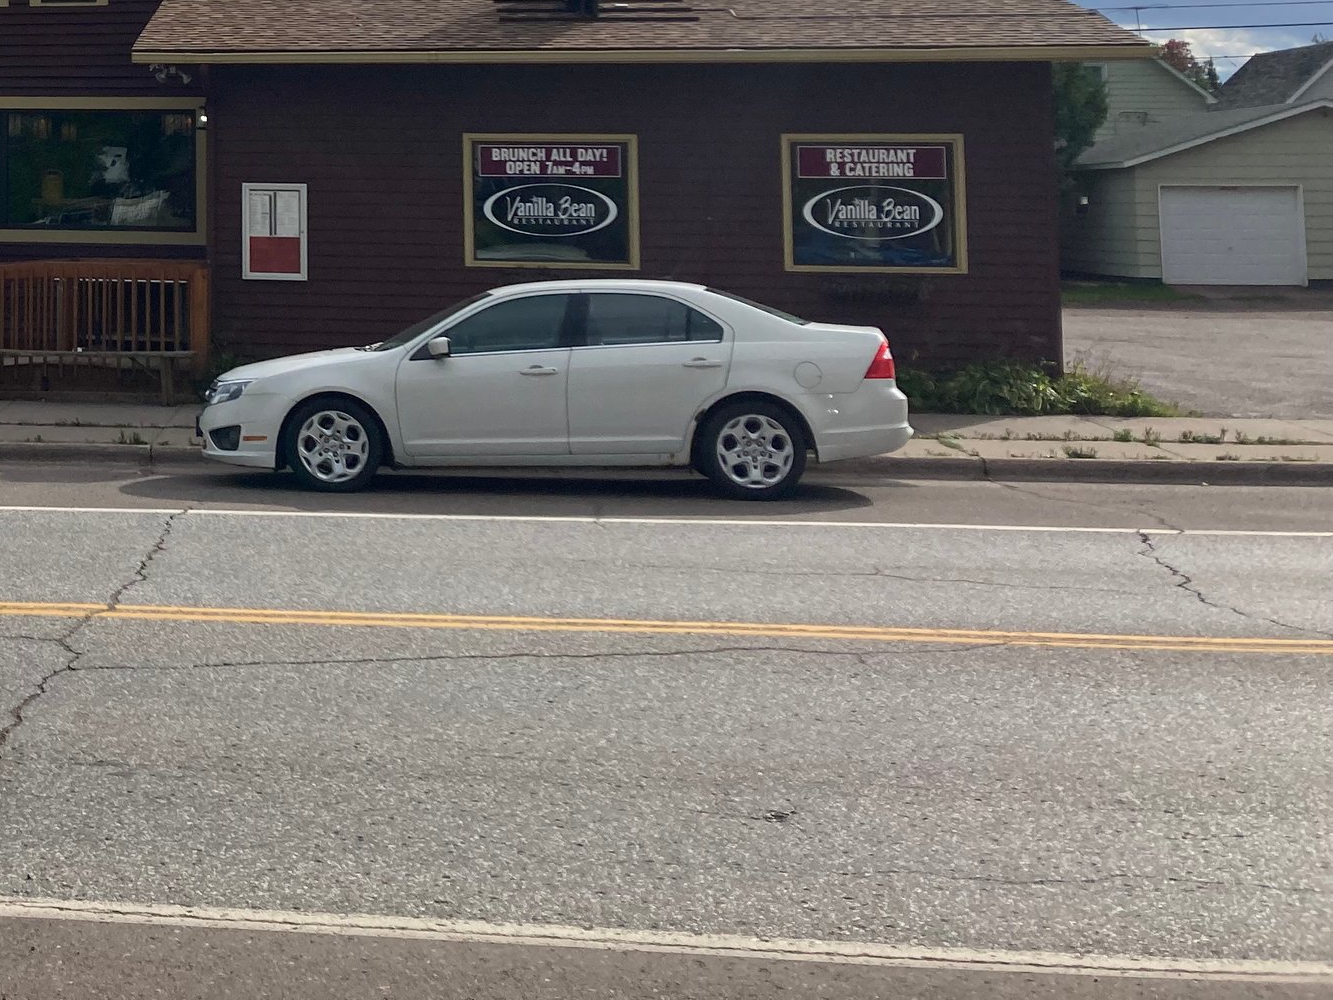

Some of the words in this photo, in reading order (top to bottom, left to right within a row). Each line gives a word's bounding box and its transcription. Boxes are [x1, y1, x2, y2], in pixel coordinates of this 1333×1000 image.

[491, 148, 546, 161] BRUNCH
[550, 148, 573, 161] ALL
[577, 148, 608, 161] DAY!
[826, 149, 916, 163] RESTAURANT
[506, 162, 540, 174] OPEN
[830, 163, 840, 176] &
[845, 163, 914, 177] CATERING
[506, 196, 554, 221] Vanilla
[558, 195, 595, 218] Bean
[827, 198, 877, 224] Vanilla
[881, 198, 920, 221] Bean
